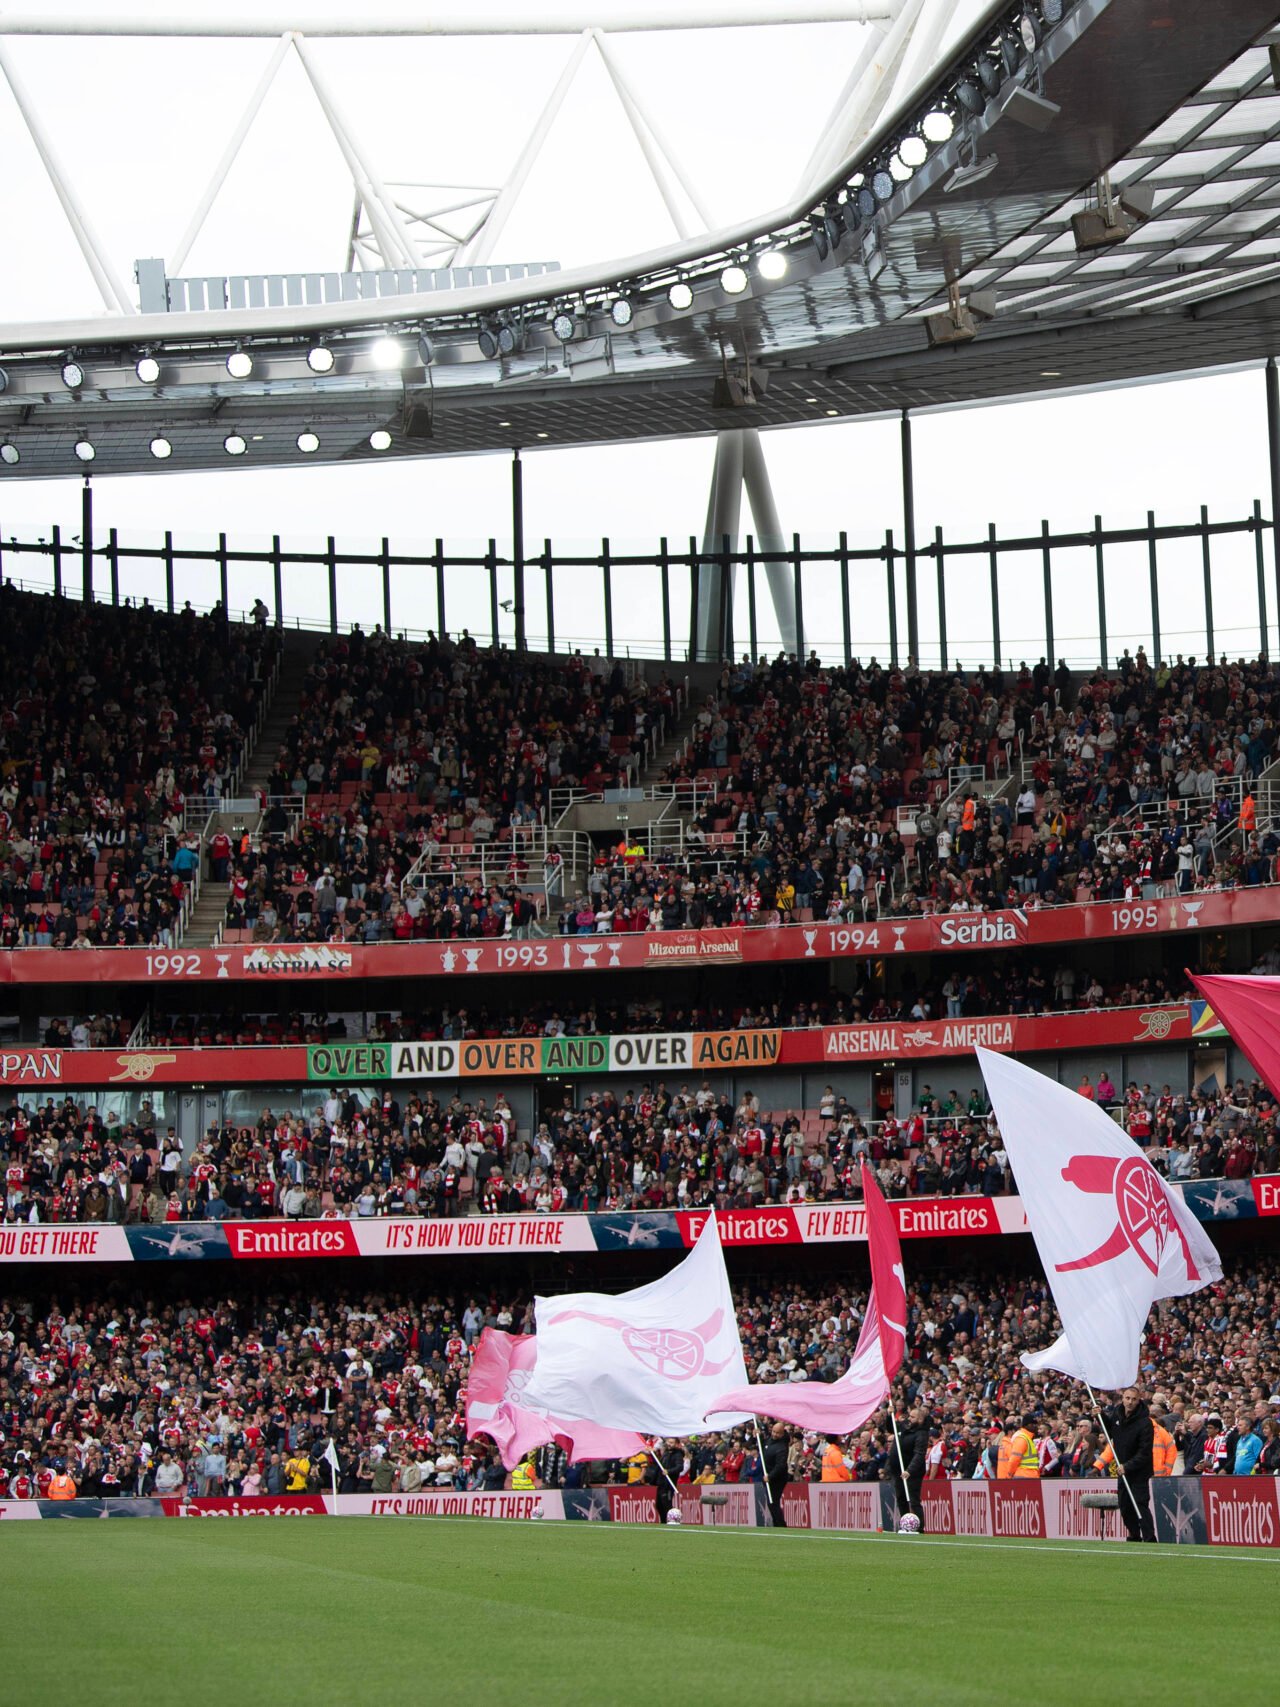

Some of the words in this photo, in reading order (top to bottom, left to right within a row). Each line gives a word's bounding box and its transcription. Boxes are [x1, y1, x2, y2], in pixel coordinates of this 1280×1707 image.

[940, 916, 1017, 945] Serbia
[1112, 906, 1158, 931] 1995
[648, 942, 697, 956] Mizoram
[699, 939, 739, 954] Arsenal
[829, 928, 880, 951] 1994
[145, 954, 201, 976] 1992
[245, 959, 321, 975] AUSTRIA
[327, 959, 350, 973] SC
[496, 946, 549, 968] 1993
[827, 1029, 899, 1054] ARSENAL
[942, 1022, 1013, 1048] AMERICA
[1, 1053, 62, 1079] PAN
[312, 1047, 387, 1076] OVER
[397, 1045, 455, 1073] AND
[463, 1043, 536, 1071] OVER
[546, 1040, 605, 1068] AND
[614, 1037, 687, 1066] OVER
[698, 1032, 779, 1063] AGAIN
[807, 1212, 831, 1237] FLY
[833, 1209, 869, 1236] BETT
[899, 1205, 988, 1232] Emirates
[21, 1232, 49, 1255] GET
[51, 1231, 99, 1255] THERE
[237, 1227, 345, 1253] Emirates
[386, 1224, 413, 1248] IT'S
[417, 1223, 451, 1247] HOW
[457, 1223, 490, 1246] YOU
[492, 1222, 519, 1246] GET
[519, 1221, 564, 1245] THERE
[613, 1492, 656, 1523] Emirates
[921, 1489, 951, 1532] mirates
[957, 1491, 967, 1534] FLY
[967, 1491, 987, 1534] BETTER
[994, 1489, 1040, 1536] Emirates
[1059, 1489, 1072, 1536] IT'S
[1208, 1488, 1274, 1544] Emirates
